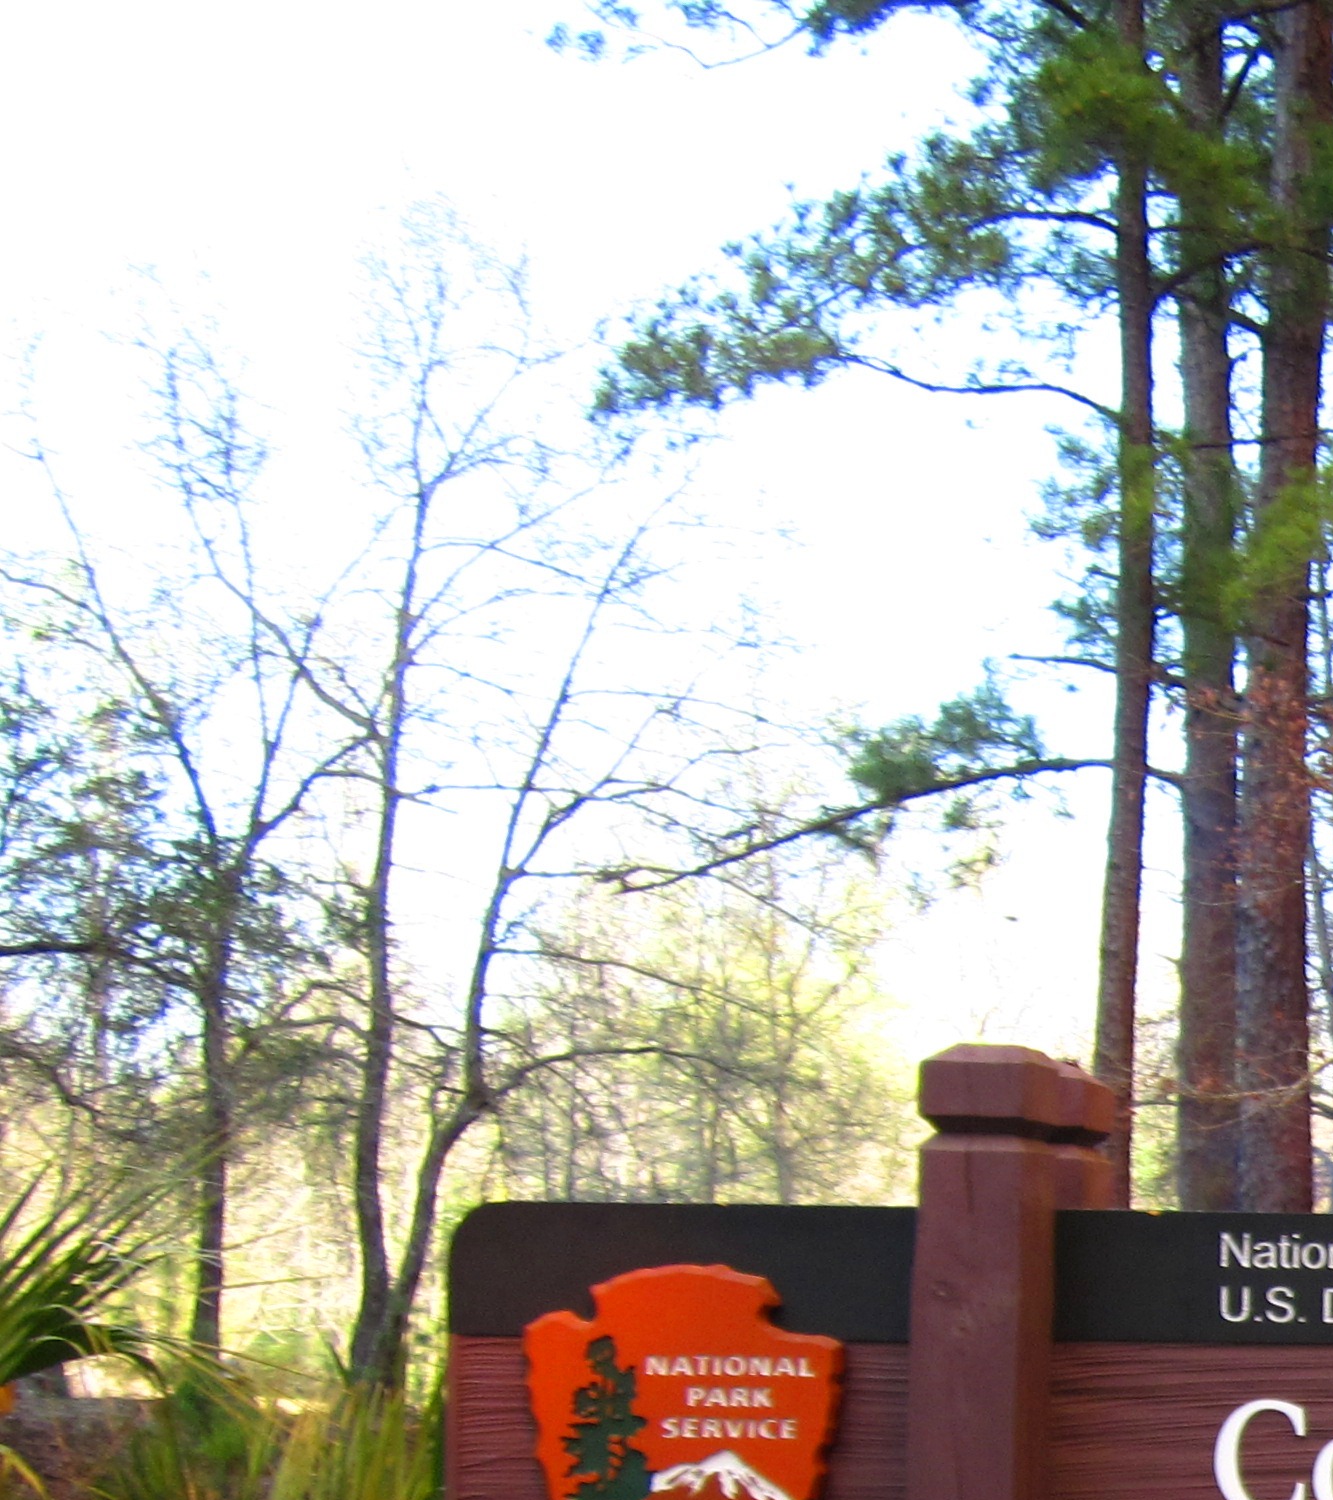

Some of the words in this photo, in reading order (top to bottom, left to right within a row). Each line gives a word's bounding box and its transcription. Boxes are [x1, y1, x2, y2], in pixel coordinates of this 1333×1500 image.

[1218, 1285, 1306, 1324] U.S.
[644, 1355, 816, 1377] NATIONAL
[685, 1386, 773, 1408] PARK
[660, 1417, 798, 1439] SERVICE
